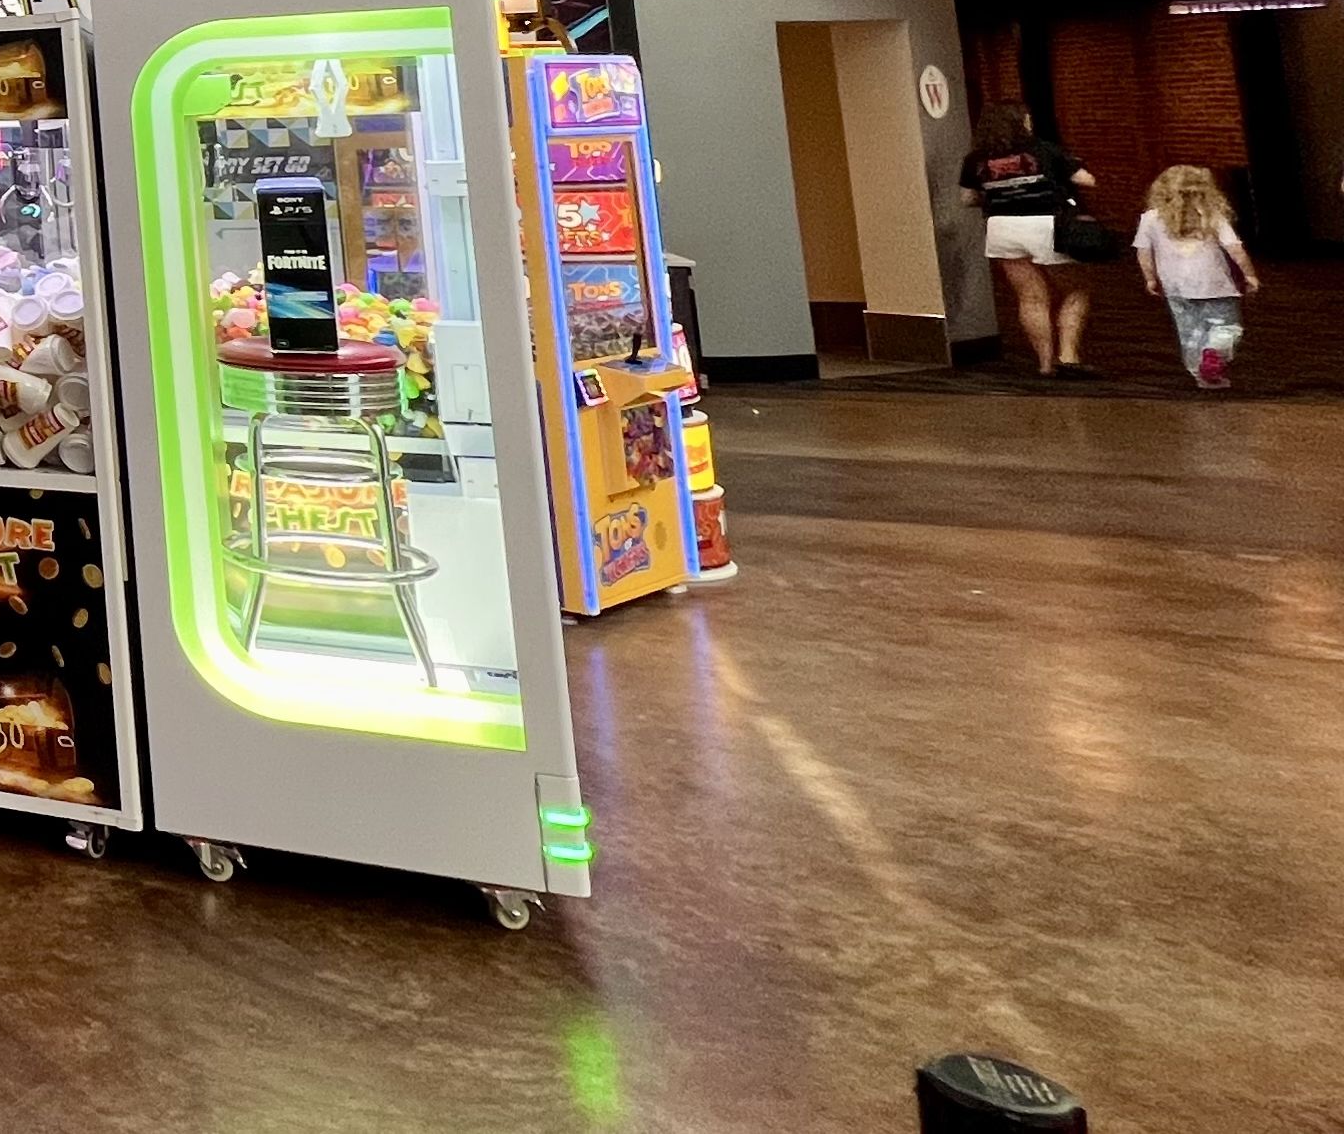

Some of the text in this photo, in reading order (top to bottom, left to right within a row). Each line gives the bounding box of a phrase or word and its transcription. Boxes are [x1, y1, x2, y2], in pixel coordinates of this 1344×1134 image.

[251, 155, 284, 175] SET
[283, 205, 313, 215] PS5
[267, 254, 327, 271] FORTNITE
[568, 280, 622, 302] TONS
[264, 502, 378, 539] HEST
